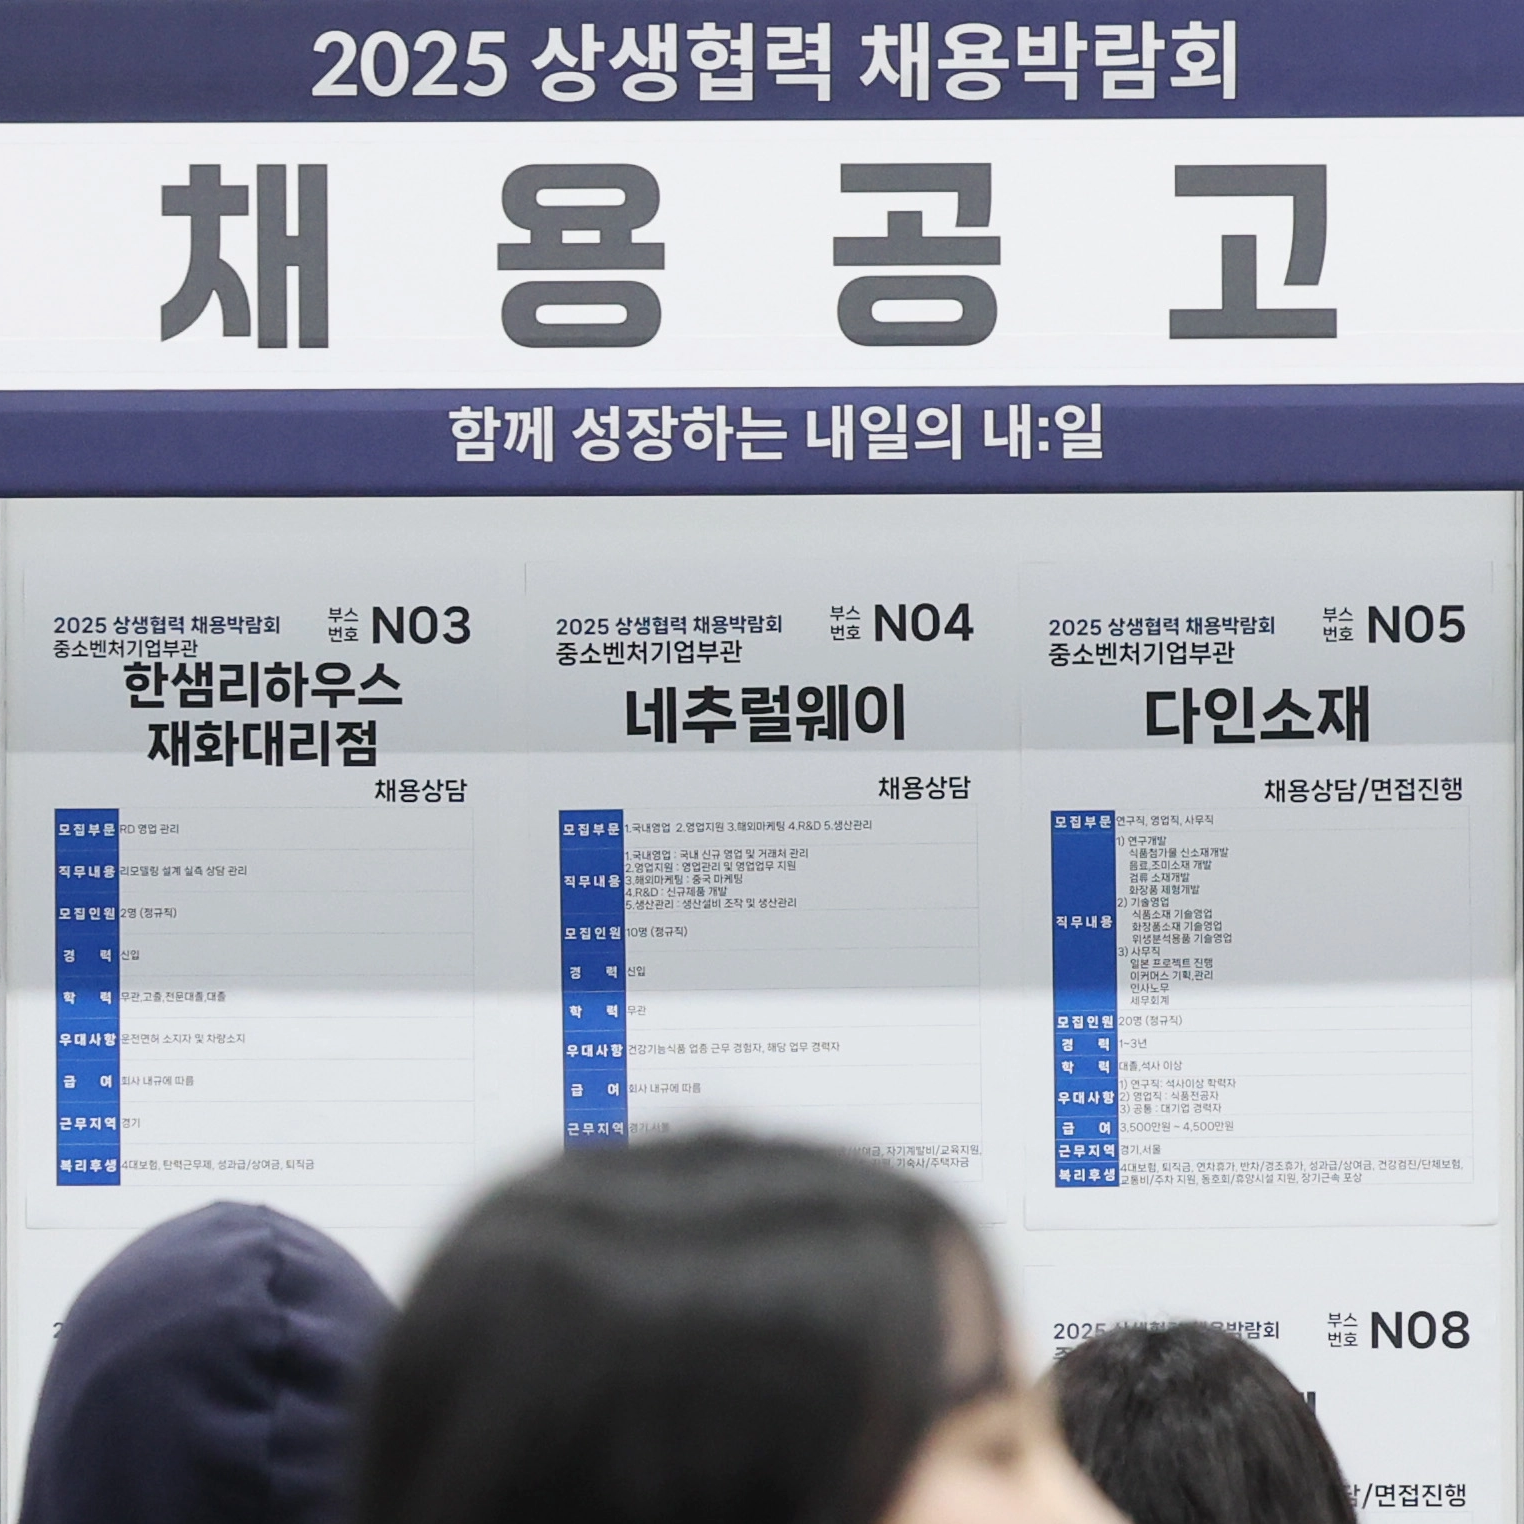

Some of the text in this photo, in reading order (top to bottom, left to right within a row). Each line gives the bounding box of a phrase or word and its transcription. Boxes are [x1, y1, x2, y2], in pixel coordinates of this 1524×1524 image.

[311, 20, 1236, 103] 2025 상생협력 채용박람회
[448, 402, 1103, 463] 함께 성장하는 내일의 내:일
[53, 615, 280, 635] 2025 상생협력 채용박람회
[327, 607, 359, 624] 부스
[372, 605, 471, 645] N03
[556, 614, 782, 636] 2025 상생협력 채용박람회
[829, 605, 861, 622] 부스
[874, 602, 975, 643] N04
[1048, 615, 1275, 637] 2025 상생협력 채용박람회
[1322, 606, 1354, 623] 부스
[1367, 604, 1466, 644] N05
[328, 626, 359, 643] 번호
[830, 624, 861, 641] 번호
[1323, 626, 1354, 643] 번호
[53, 639, 199, 659] 중소벤처기업부관
[555, 639, 743, 667] 중소벤처기업부관
[1048, 640, 1236, 667] 중소벤처기업부관
[123, 660, 403, 709] 한샘리하우스
[626, 683, 905, 744] 네추럴웨이
[1146, 685, 1370, 745] 다인소재
[147, 719, 377, 768] 재화대리점
[374, 778, 468, 803] 채용상담
[878, 775, 972, 801] 채용상담
[1264, 777, 1463, 805] 채용상담/면접진행
[1327, 1312, 1358, 1328] 부스
[1371, 1310, 1470, 1350] N08
[1327, 1331, 1358, 1348] 번호
